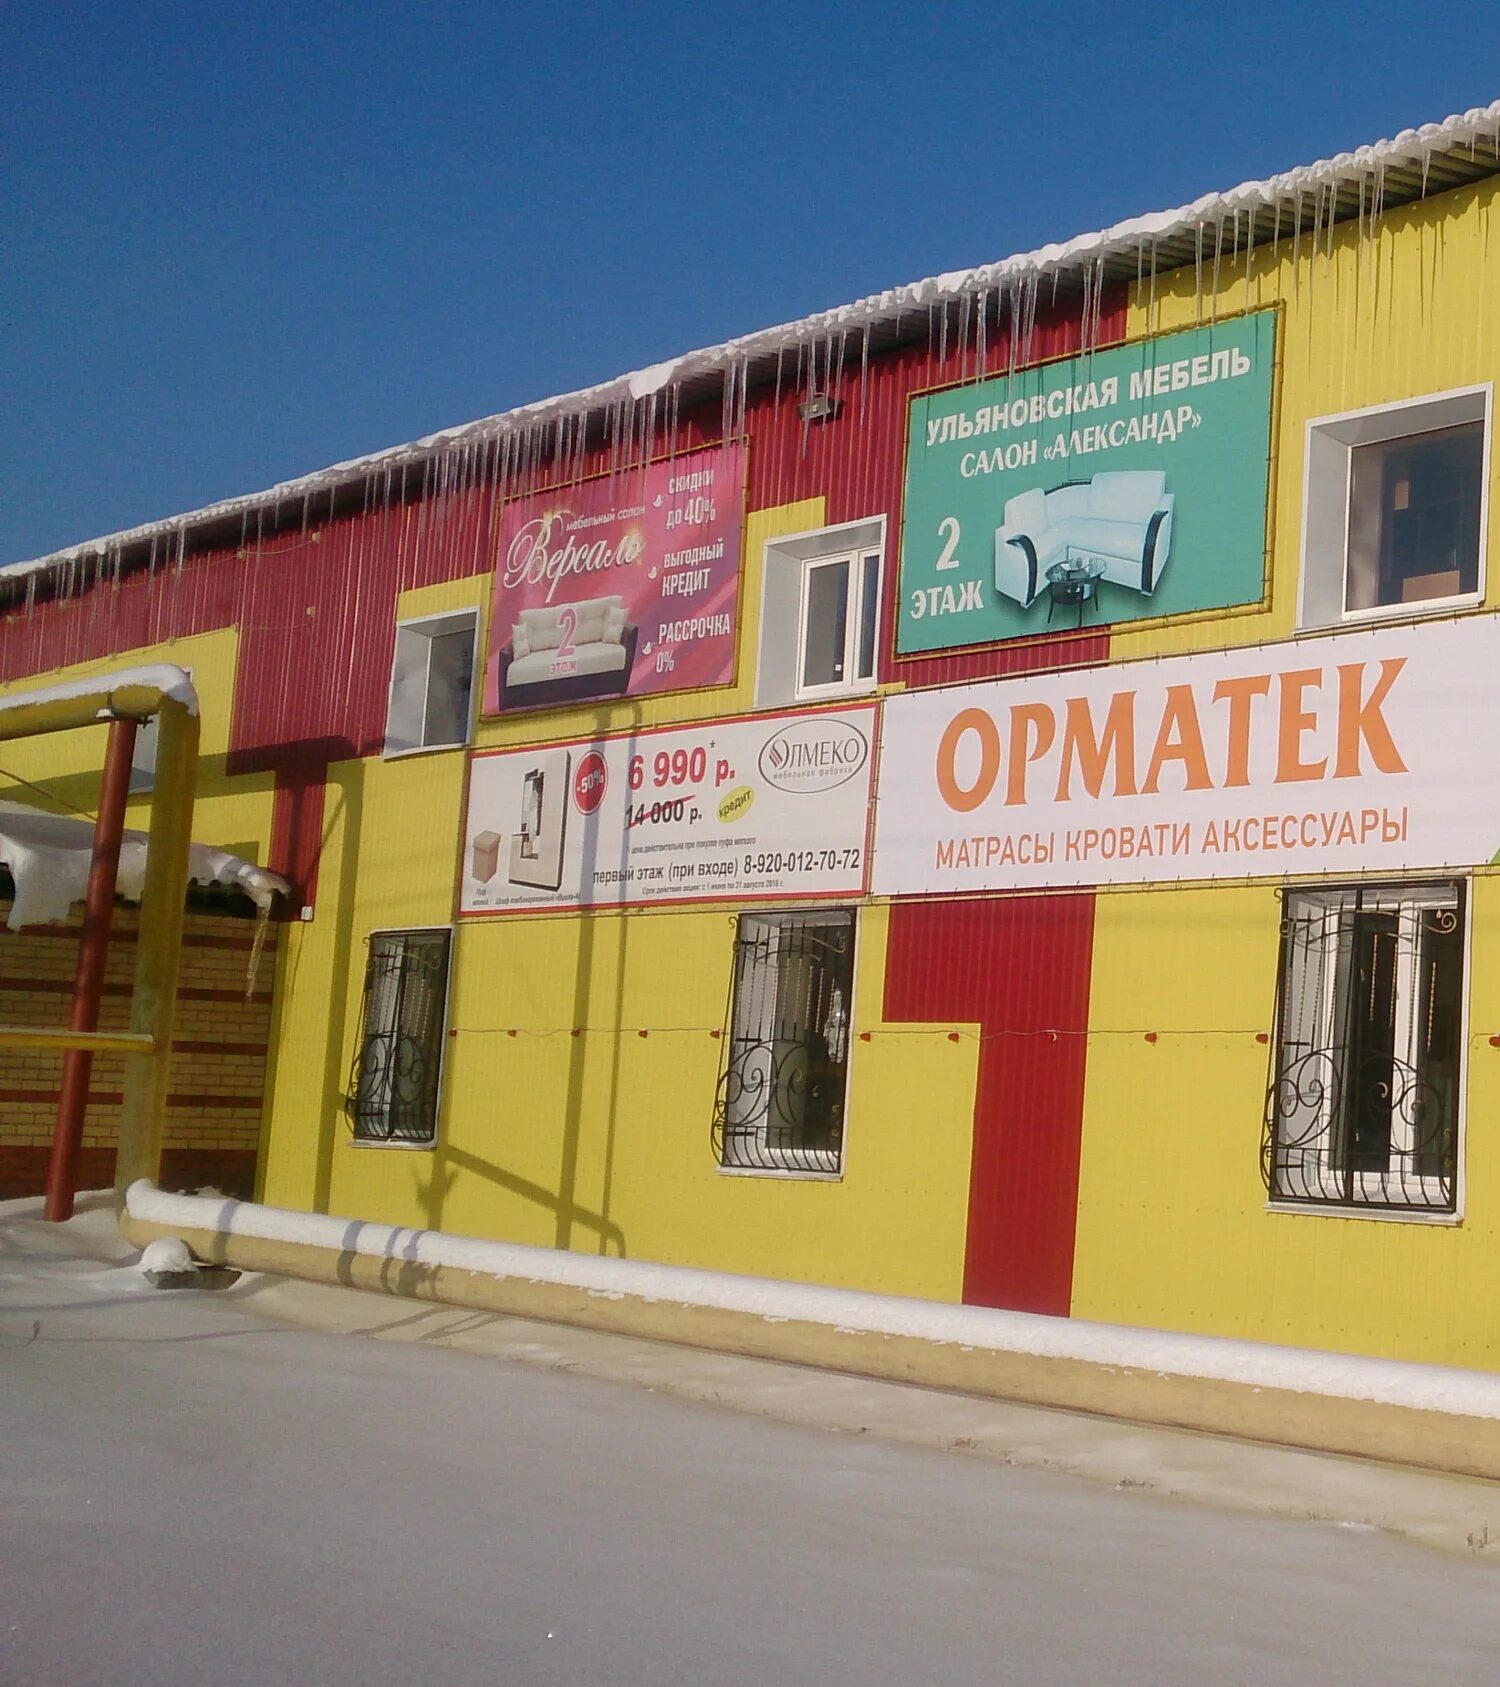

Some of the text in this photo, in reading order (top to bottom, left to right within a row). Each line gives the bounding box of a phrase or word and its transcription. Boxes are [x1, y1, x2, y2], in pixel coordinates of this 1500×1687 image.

[926, 347, 1251, 447] УЛЬЯНОВСКАЯ МЕБЕЛЬ
[959, 405, 1203, 478] САЛОН «АЛЕКСАНДР»
[566, 506, 646, 532] мебельный салон
[684, 496, 716, 525] 40%
[503, 512, 646, 603] Версаль
[935, 517, 961, 571] 2
[661, 568, 711, 597] КРЕДИТ
[910, 580, 984, 619] ЭТАЖ
[556, 607, 577, 659] 2
[658, 613, 731, 645] РАССРОЧКА
[655, 650, 675, 673] 0%
[769, 738, 859, 770] ОЛМЕКО
[936, 656, 1410, 813] ОРМАТЕК
[577, 768, 604, 794] -50%
[628, 747, 735, 790] 6 990 р.
[626, 800, 702, 826] 14 000 р.
[718, 790, 751, 818] кредит
[936, 806, 1409, 870] МАТРАСЫ КРОВАТИ АКСЕССУАРЫ
[592, 848, 860, 887] первый этаж (при входе) 8-920-012-70-72
